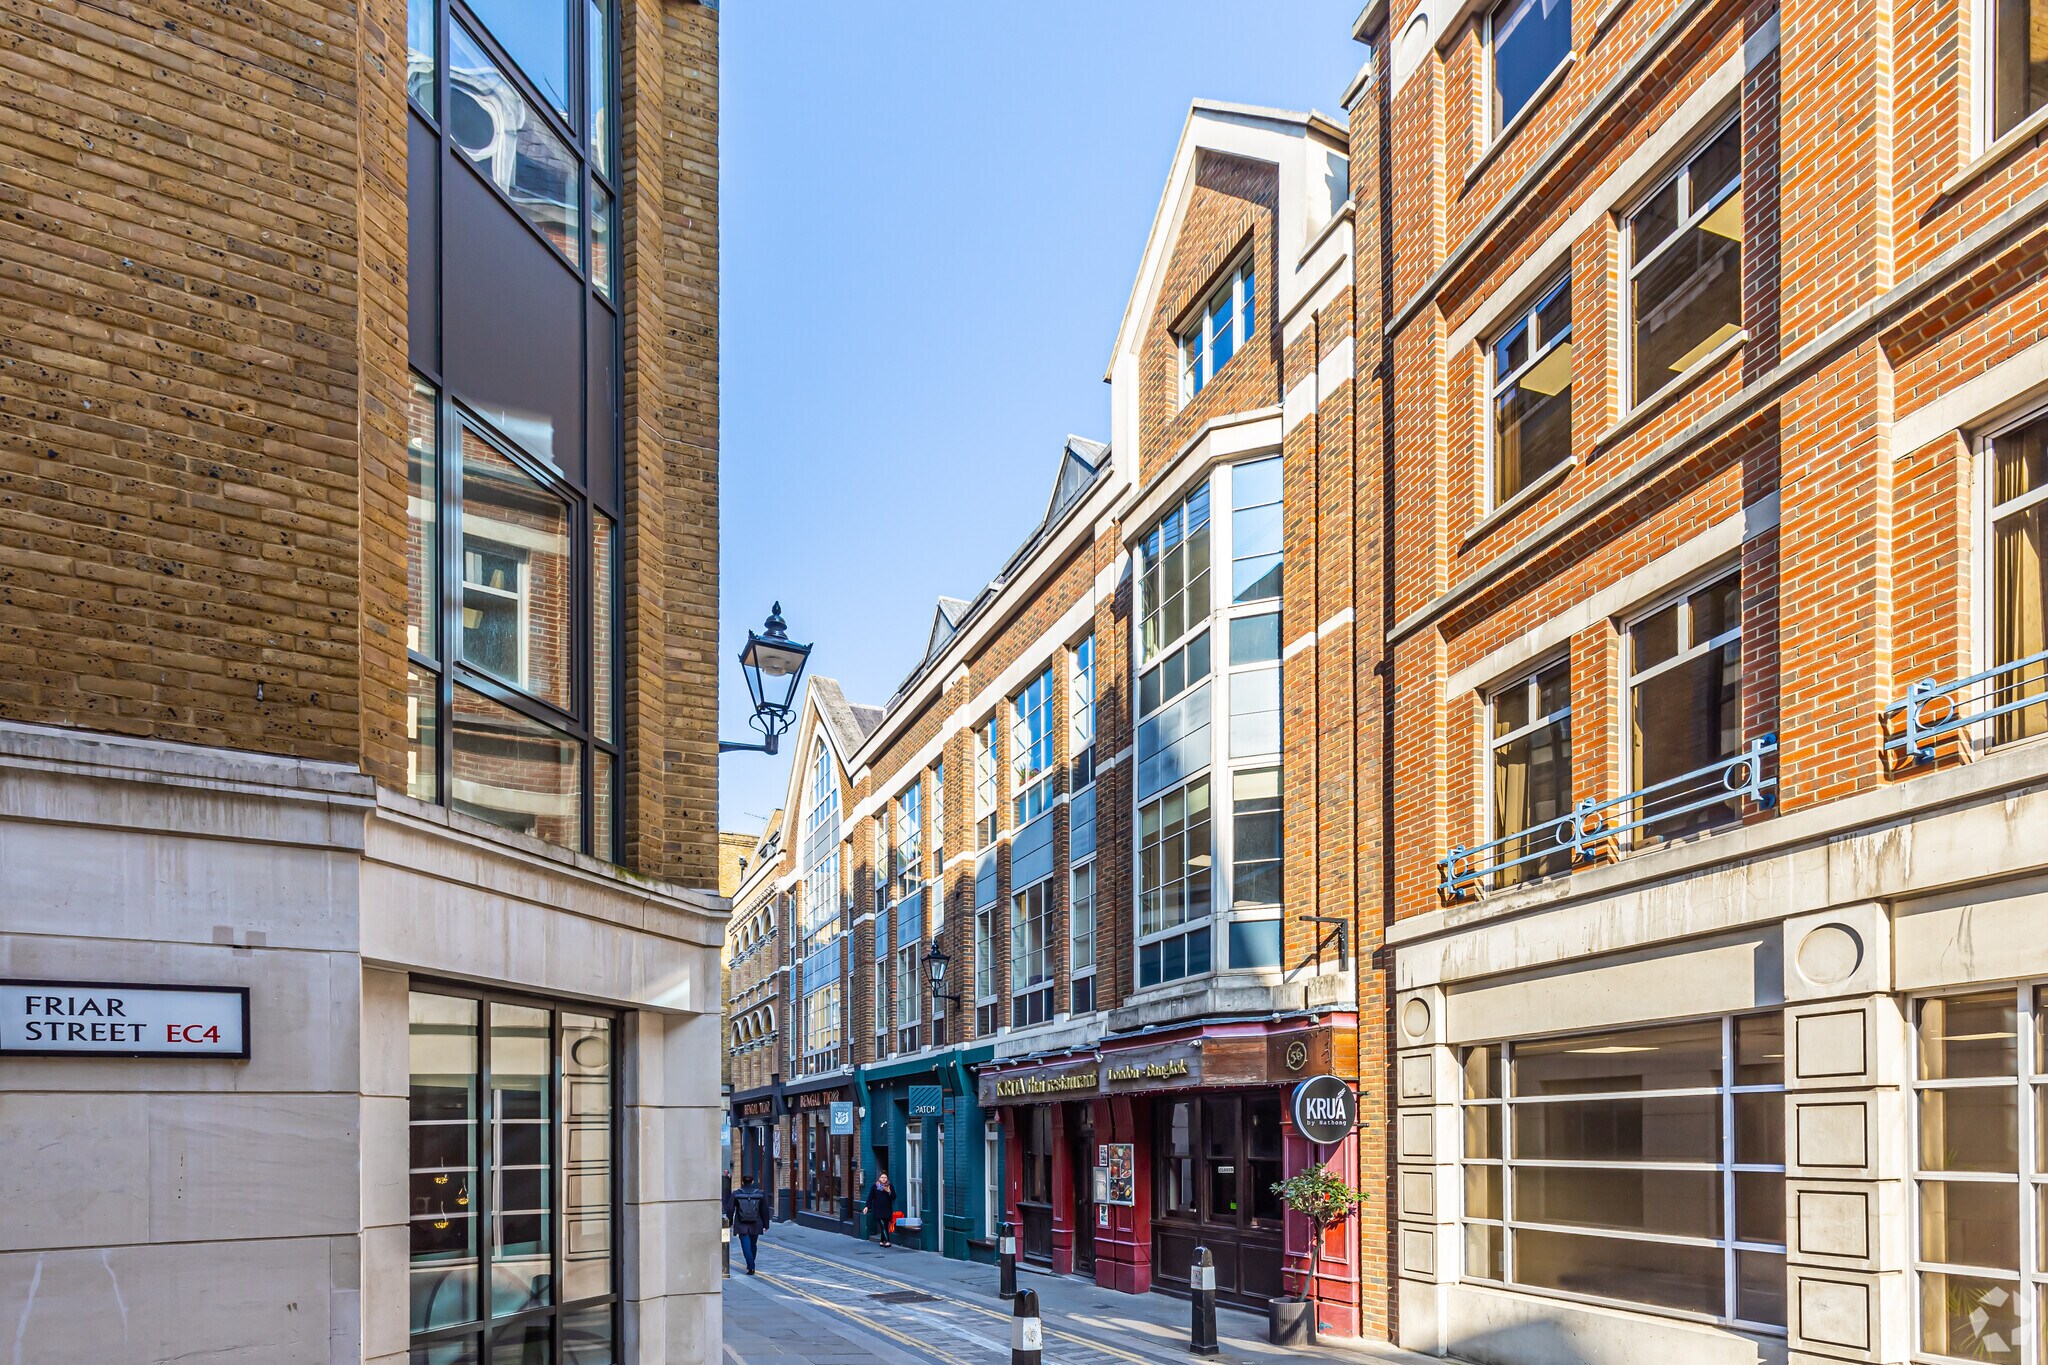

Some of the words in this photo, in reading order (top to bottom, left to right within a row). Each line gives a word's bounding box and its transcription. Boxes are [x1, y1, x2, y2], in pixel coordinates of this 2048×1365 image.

[25, 995, 127, 1017] FRIAR
[25, 1021, 147, 1042] STREET
[166, 1024, 221, 1043] EC4
[1290, 1047, 1303, 1064] 56
[1108, 1065, 1139, 1081] London
[1147, 1058, 1187, 1079] Bangkok
[996, 1077, 1026, 1097] KRUA
[1028, 1074, 1046, 1094] thai
[1046, 1070, 1097, 1092] restaurant
[800, 1092, 821, 1107] BENGAL
[915, 1105, 936, 1114] PATCH
